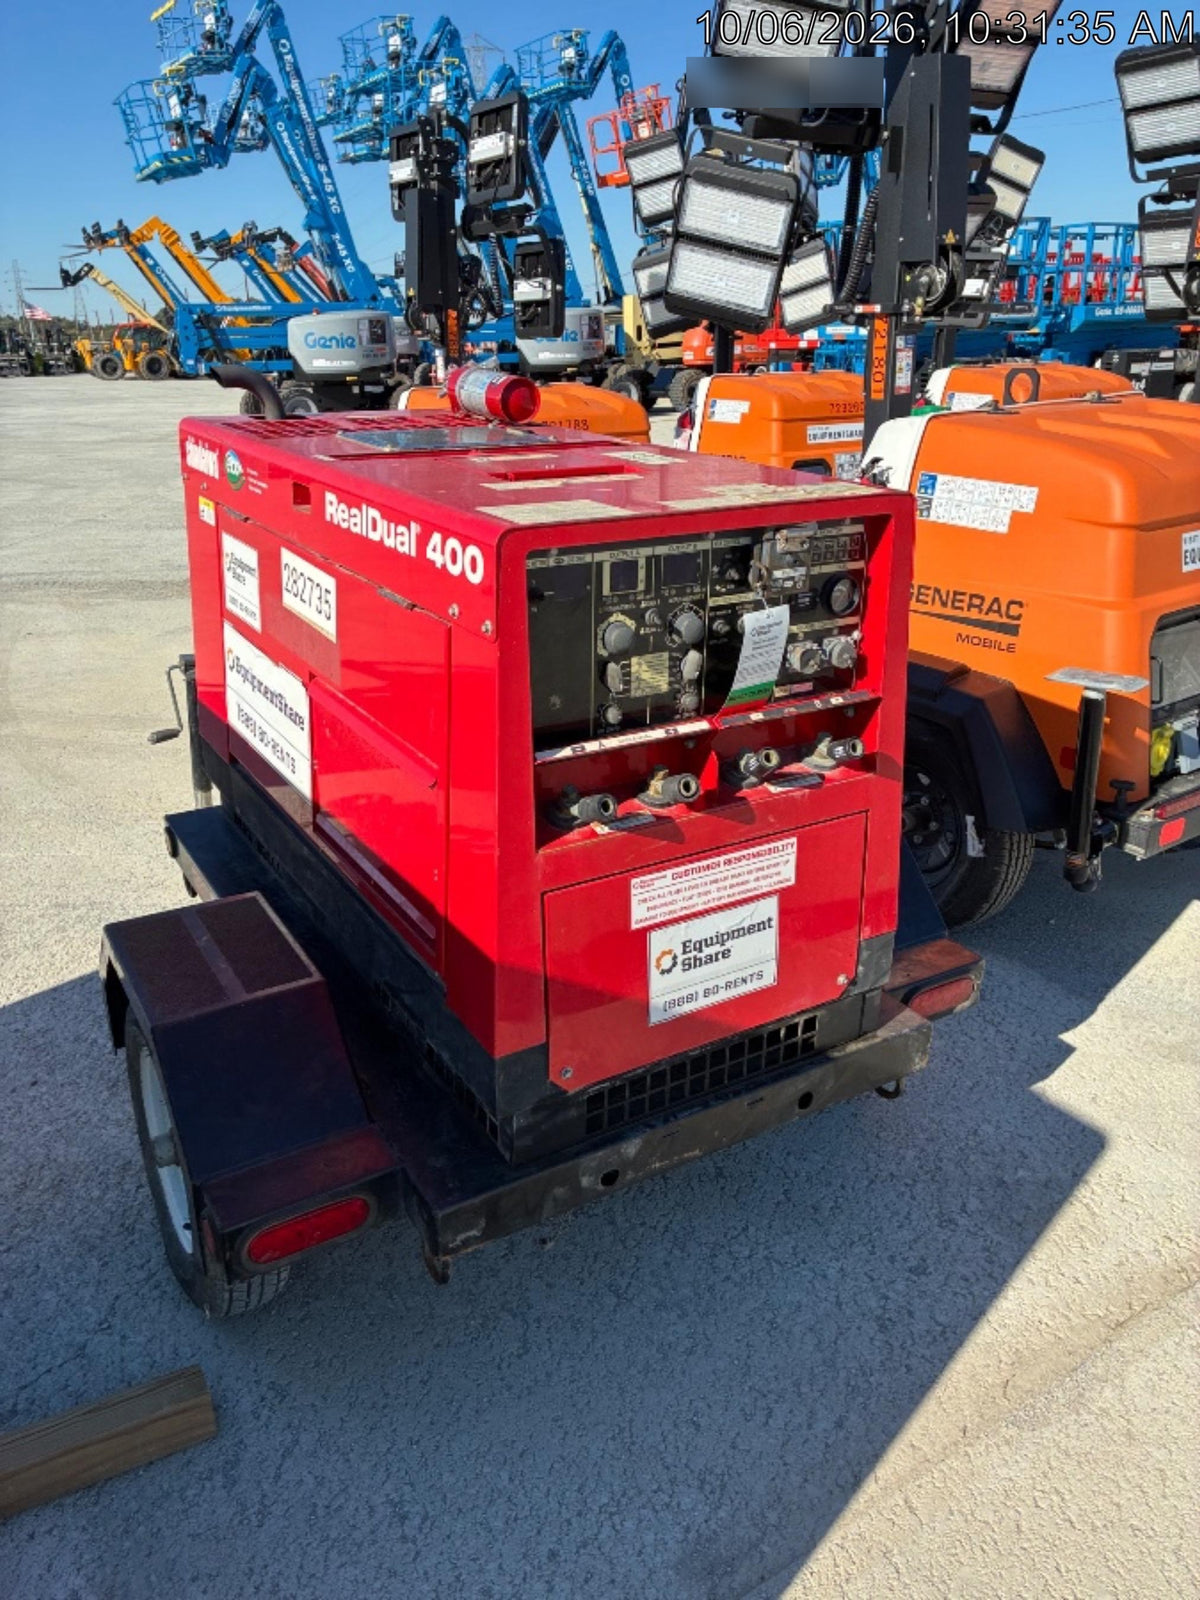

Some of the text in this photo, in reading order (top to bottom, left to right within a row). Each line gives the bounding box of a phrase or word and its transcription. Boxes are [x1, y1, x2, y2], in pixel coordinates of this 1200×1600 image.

[304, 331, 357, 350] Genie
[426, 532, 485, 585] 400
[284, 562, 332, 621] 282735
[956, 632, 1017, 653] MOBILE
[681, 916, 774, 956] Equipment
[681, 946, 733, 973] Share
[663, 970, 764, 1013] (888) 80-RENTS
